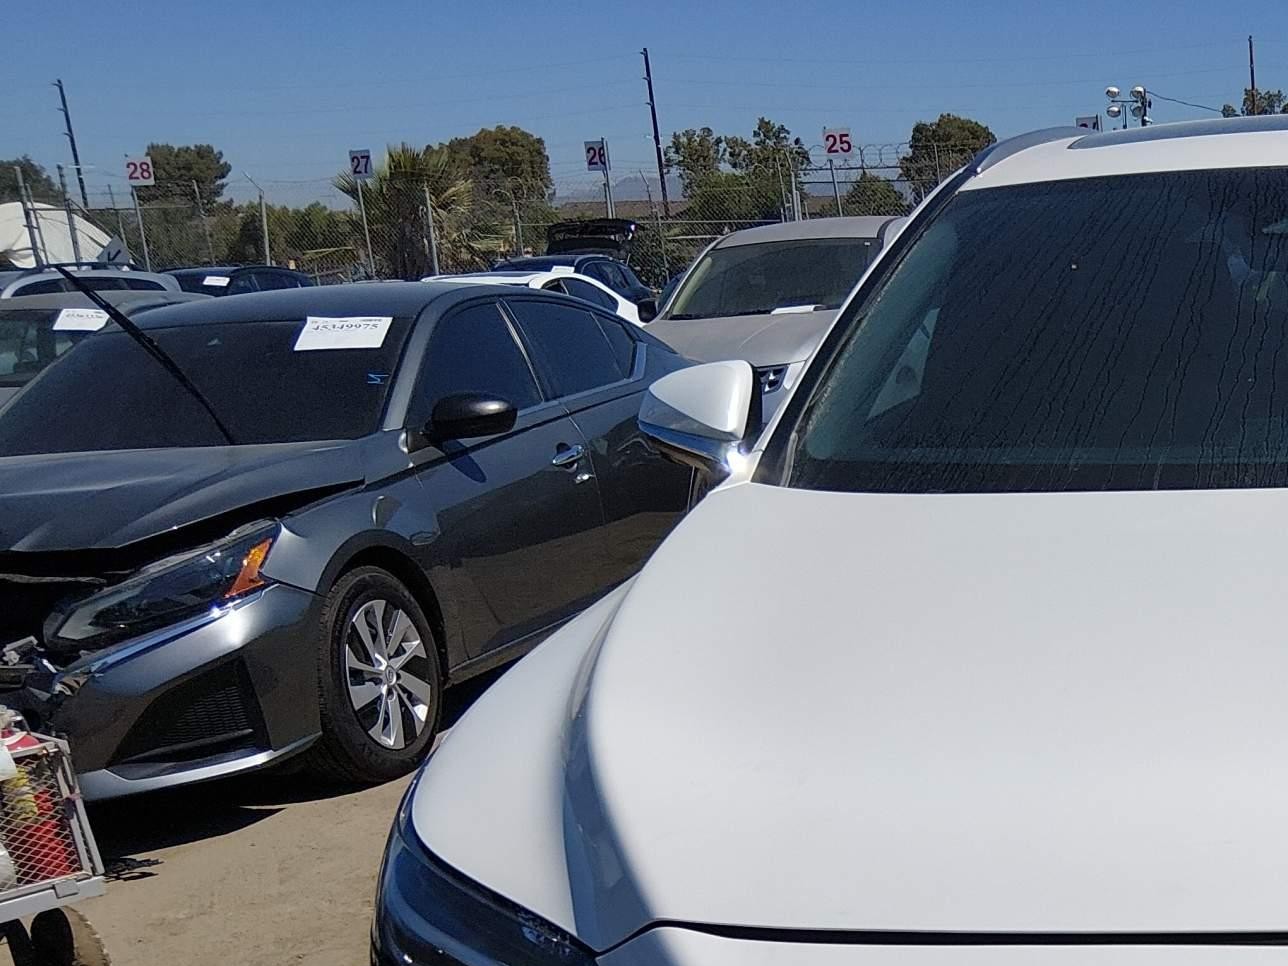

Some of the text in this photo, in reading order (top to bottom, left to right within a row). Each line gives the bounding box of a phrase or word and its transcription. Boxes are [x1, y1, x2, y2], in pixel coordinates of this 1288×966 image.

[825, 133, 852, 153] 25
[126, 161, 152, 180] 28
[351, 155, 370, 175] 27
